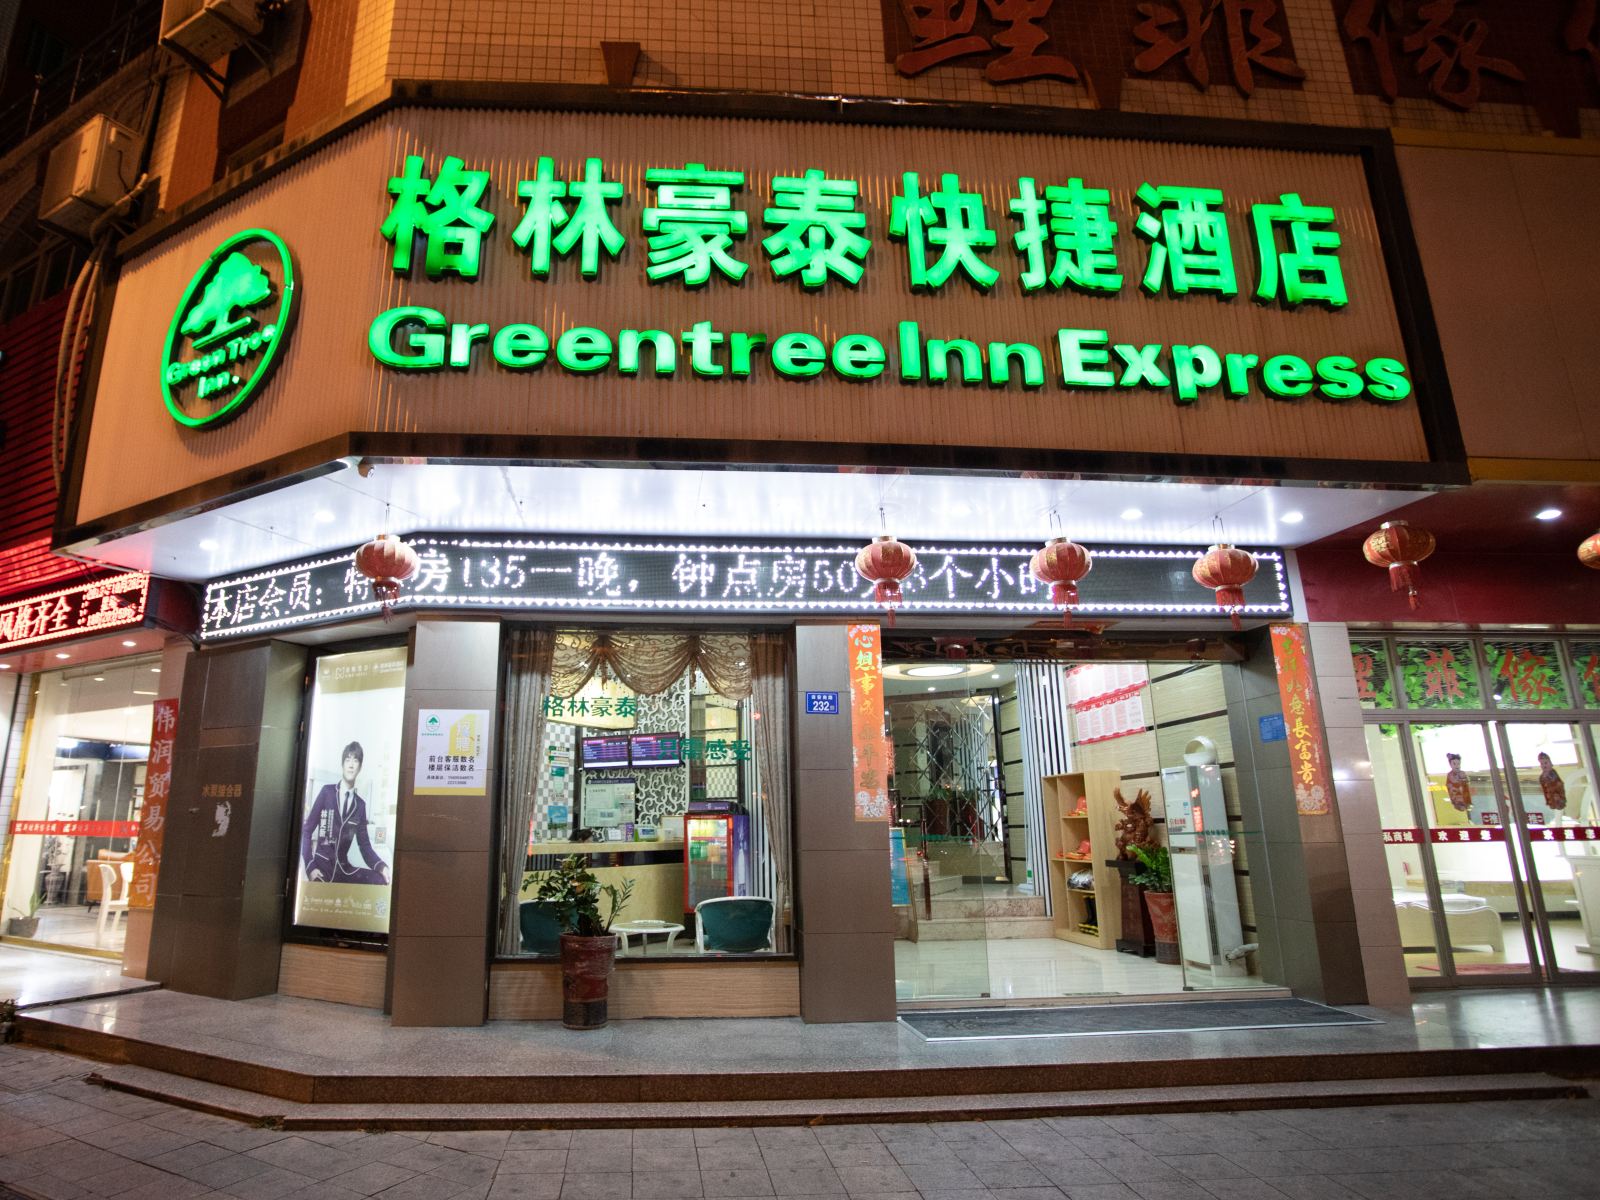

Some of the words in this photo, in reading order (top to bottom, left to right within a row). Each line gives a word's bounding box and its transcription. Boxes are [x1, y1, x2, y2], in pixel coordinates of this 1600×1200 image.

[380, 155, 1348, 306] 格林豪泰快捷酒店
[166, 348, 227, 386] Green
[226, 323, 277, 361] Tree
[368, 306, 887, 379] Greentree
[897, 320, 1045, 386] Inn
[1058, 328, 1412, 402] Express
[543, 695, 637, 718] 格林豪泰
[428, 755, 475, 763] 前台客服数名
[428, 764, 475, 772] 楼层保洁数名
[134, 704, 176, 901] 伟润贸易公司
[1438, 830, 1494, 842] 欢迎您
[1542, 829, 1597, 841] 欢迎您
